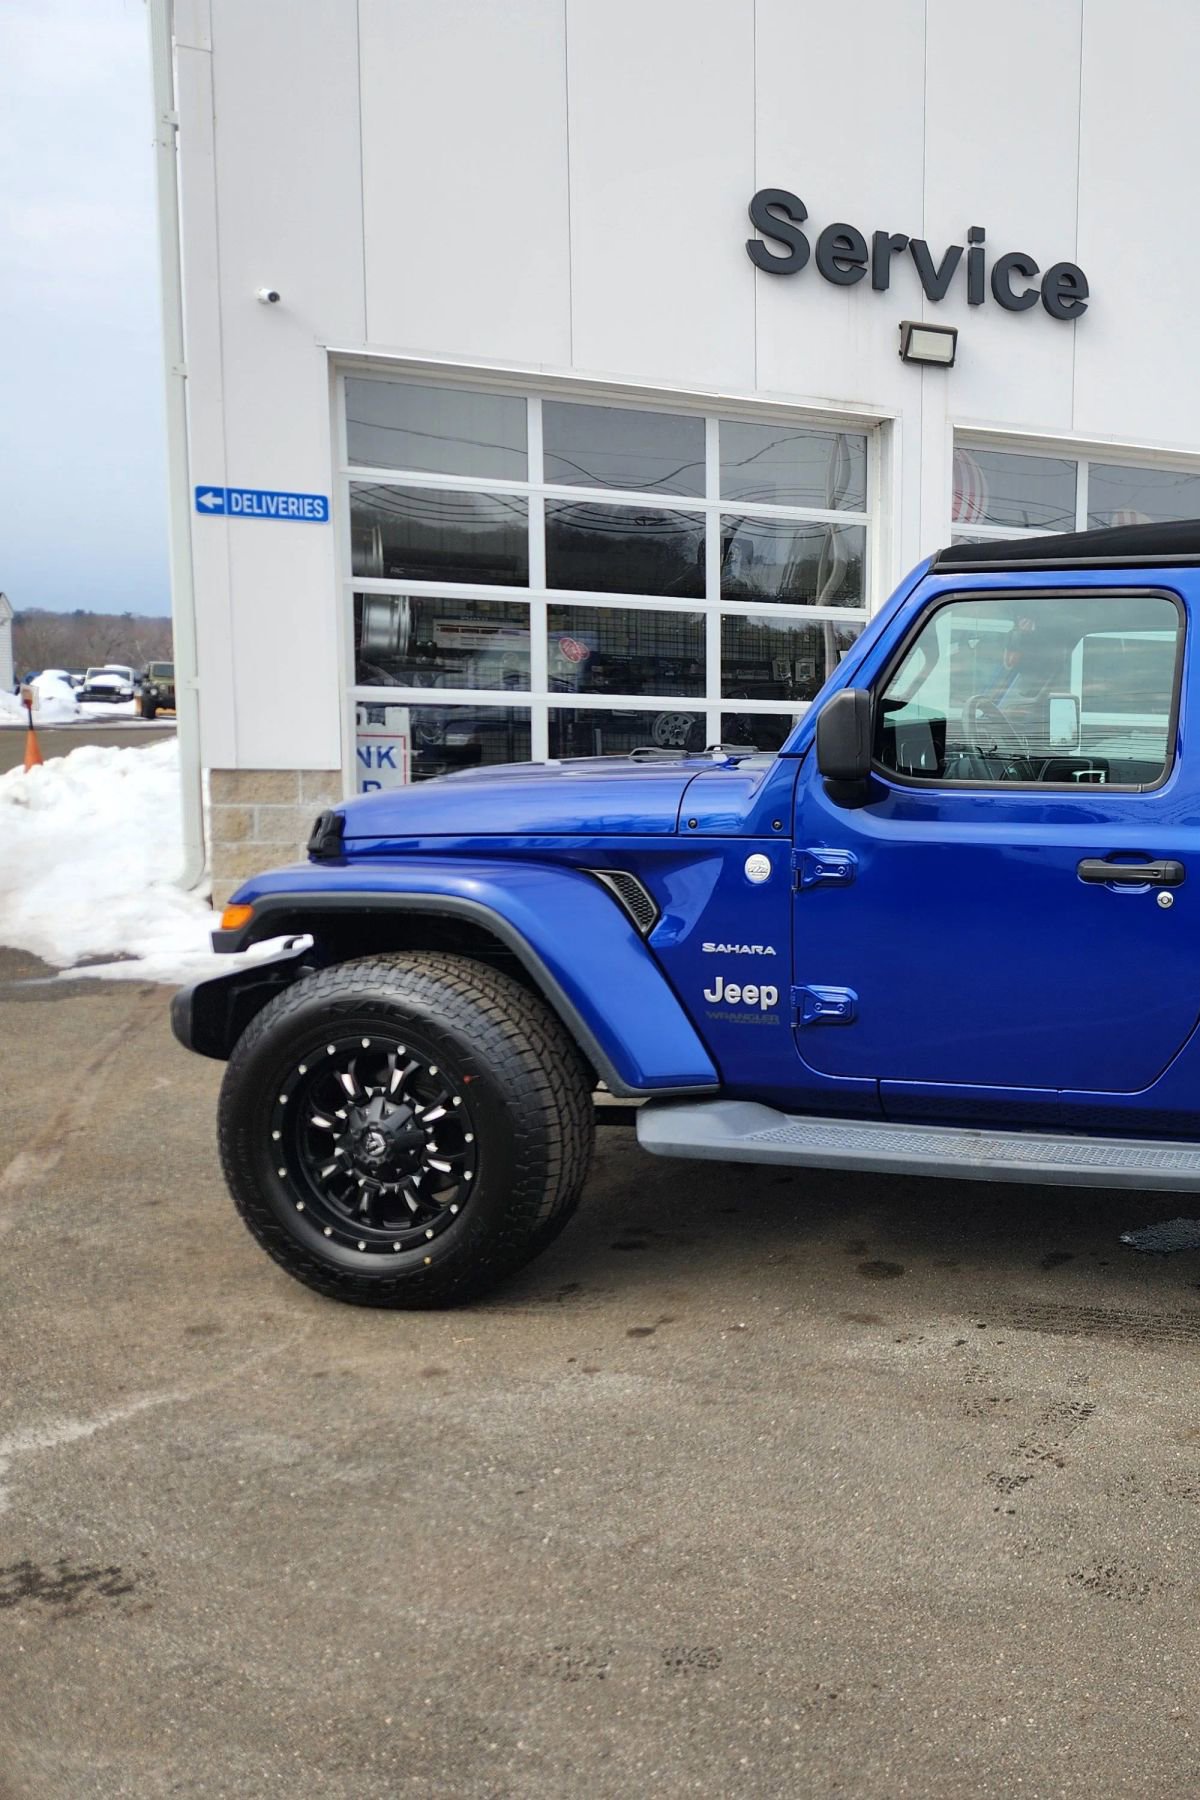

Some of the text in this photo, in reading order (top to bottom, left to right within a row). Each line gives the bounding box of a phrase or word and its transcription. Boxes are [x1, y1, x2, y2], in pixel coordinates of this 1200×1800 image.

[746, 187, 1090, 321] Service
[231, 492, 325, 519] DELIVERIES
[702, 942, 777, 956] SAHARA
[703, 976, 778, 1011] Jeep
